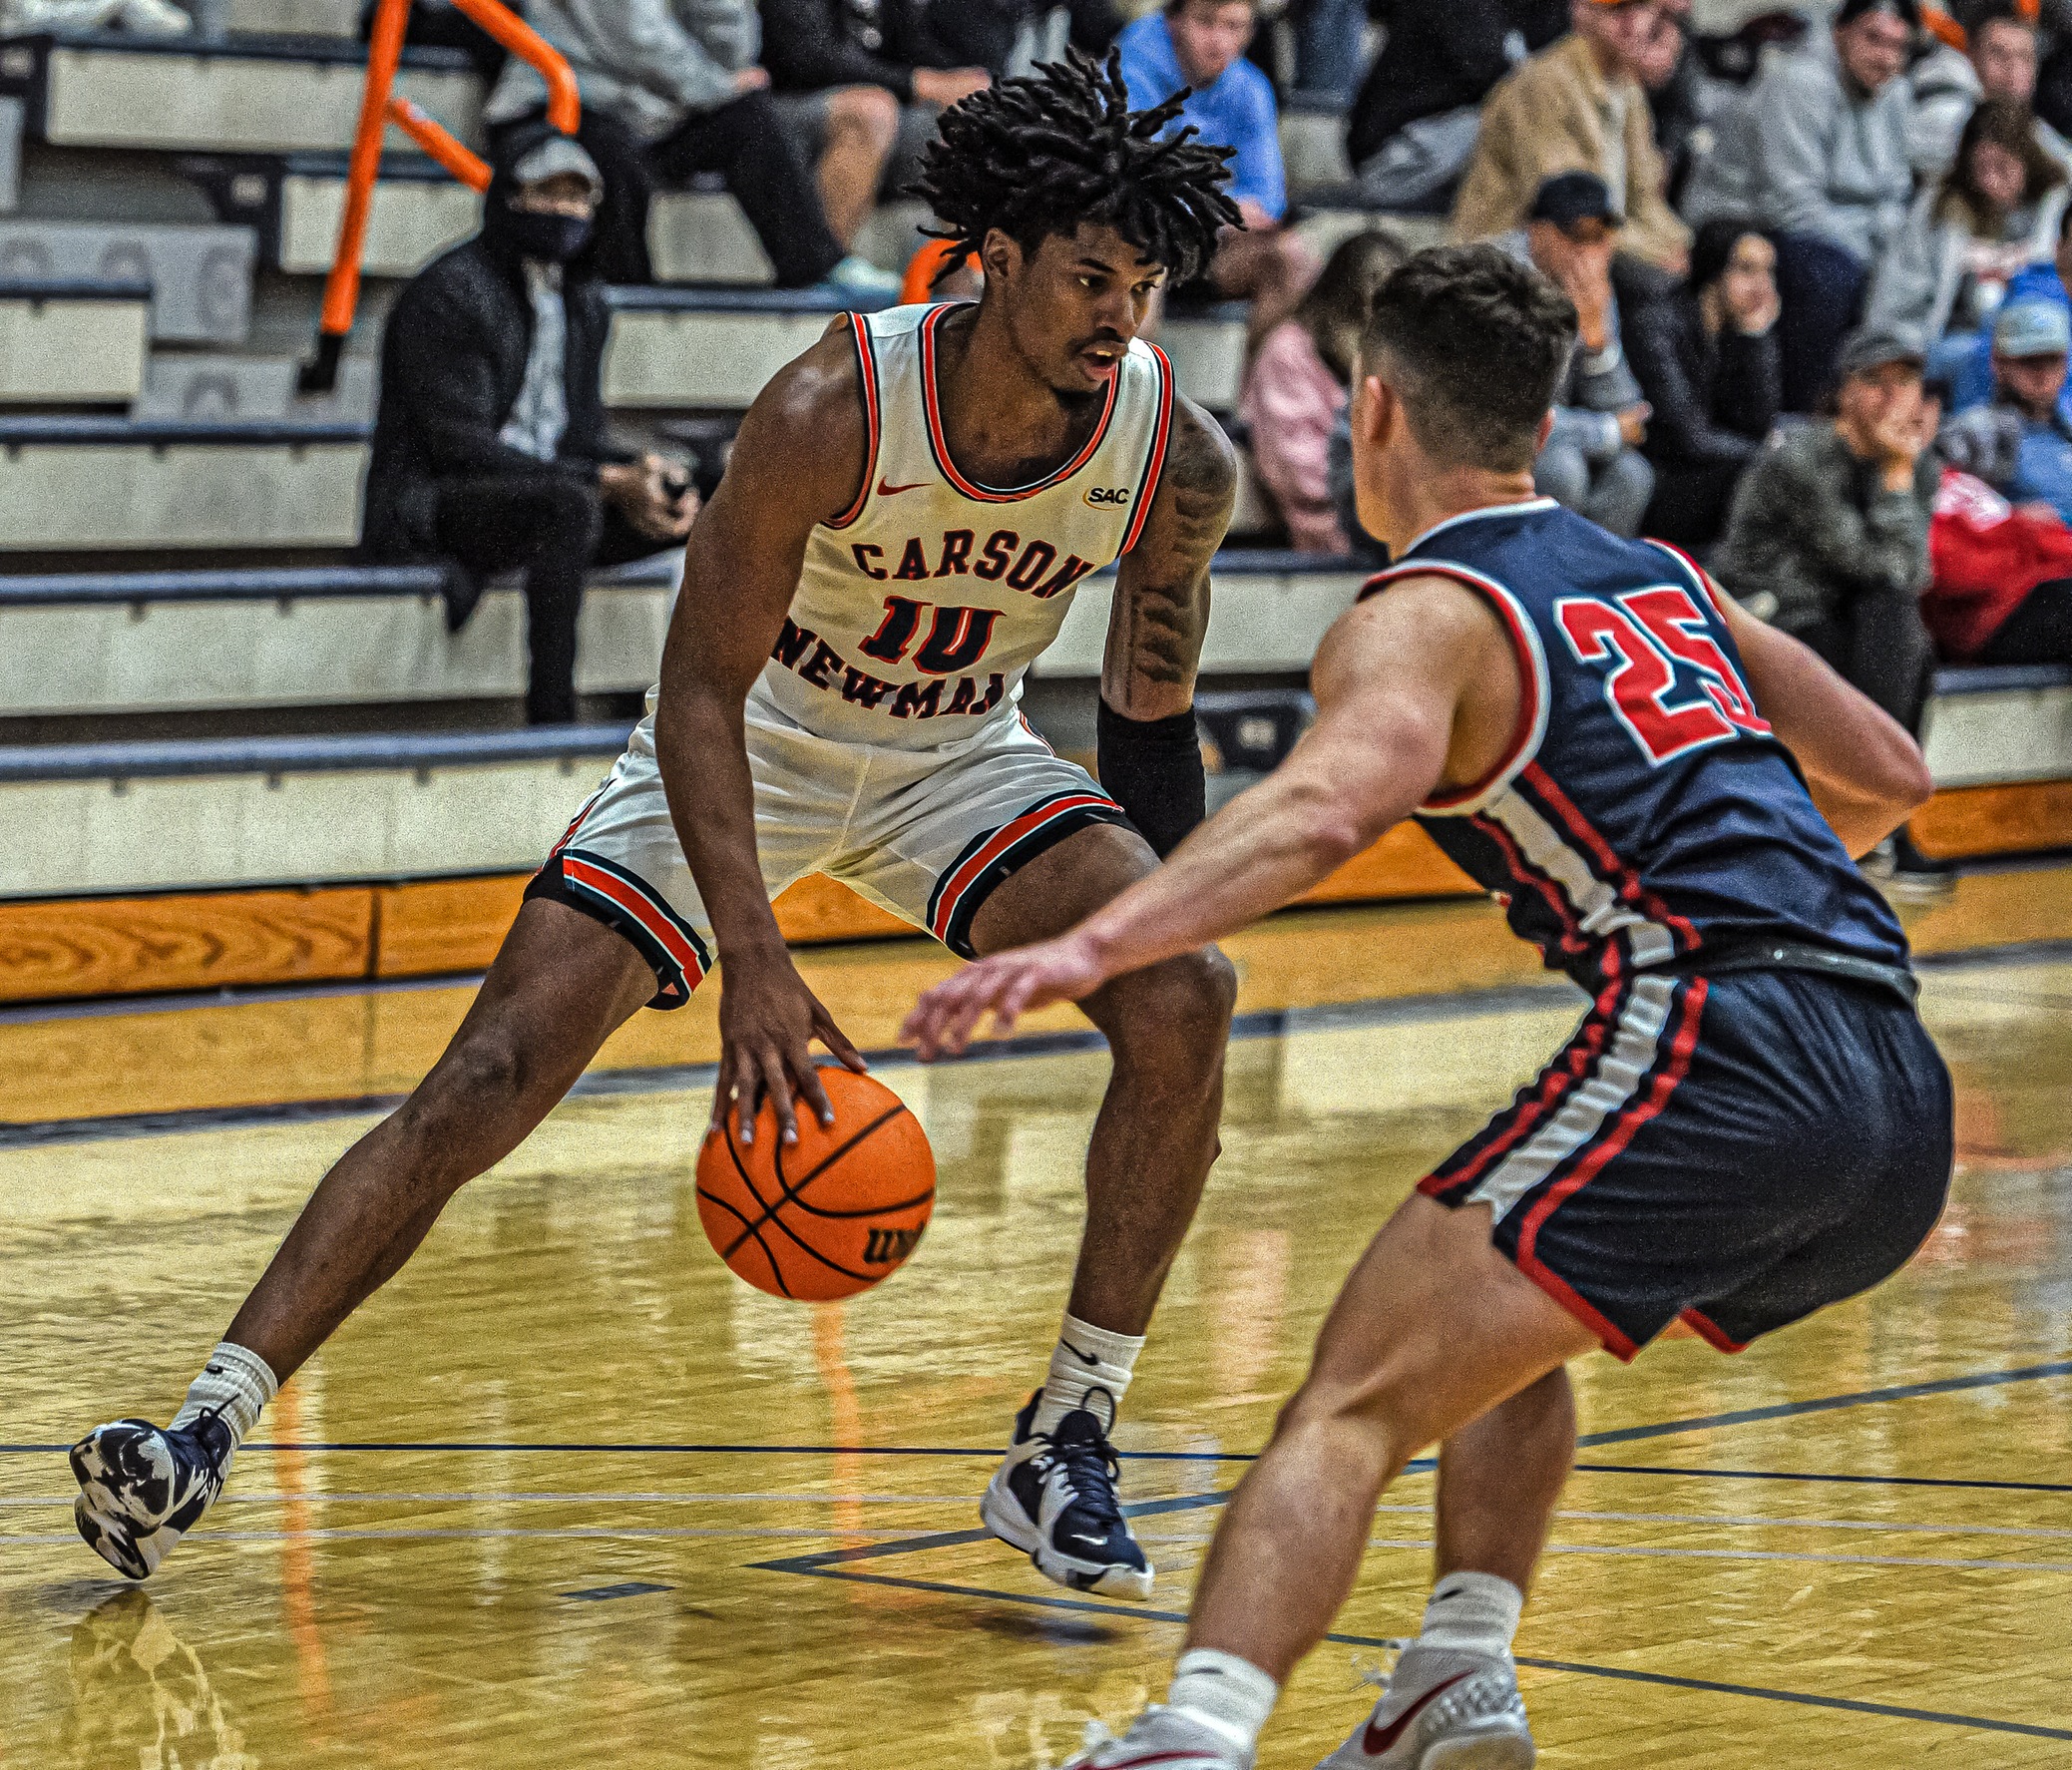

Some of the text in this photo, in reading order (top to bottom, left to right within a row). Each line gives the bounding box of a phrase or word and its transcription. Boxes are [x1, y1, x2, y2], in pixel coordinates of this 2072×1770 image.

[1087, 487, 1129, 505] SAC
[851, 529, 1095, 599] CARSON
[858, 595, 1008, 675] 10
[1554, 583, 1773, 767] 25
